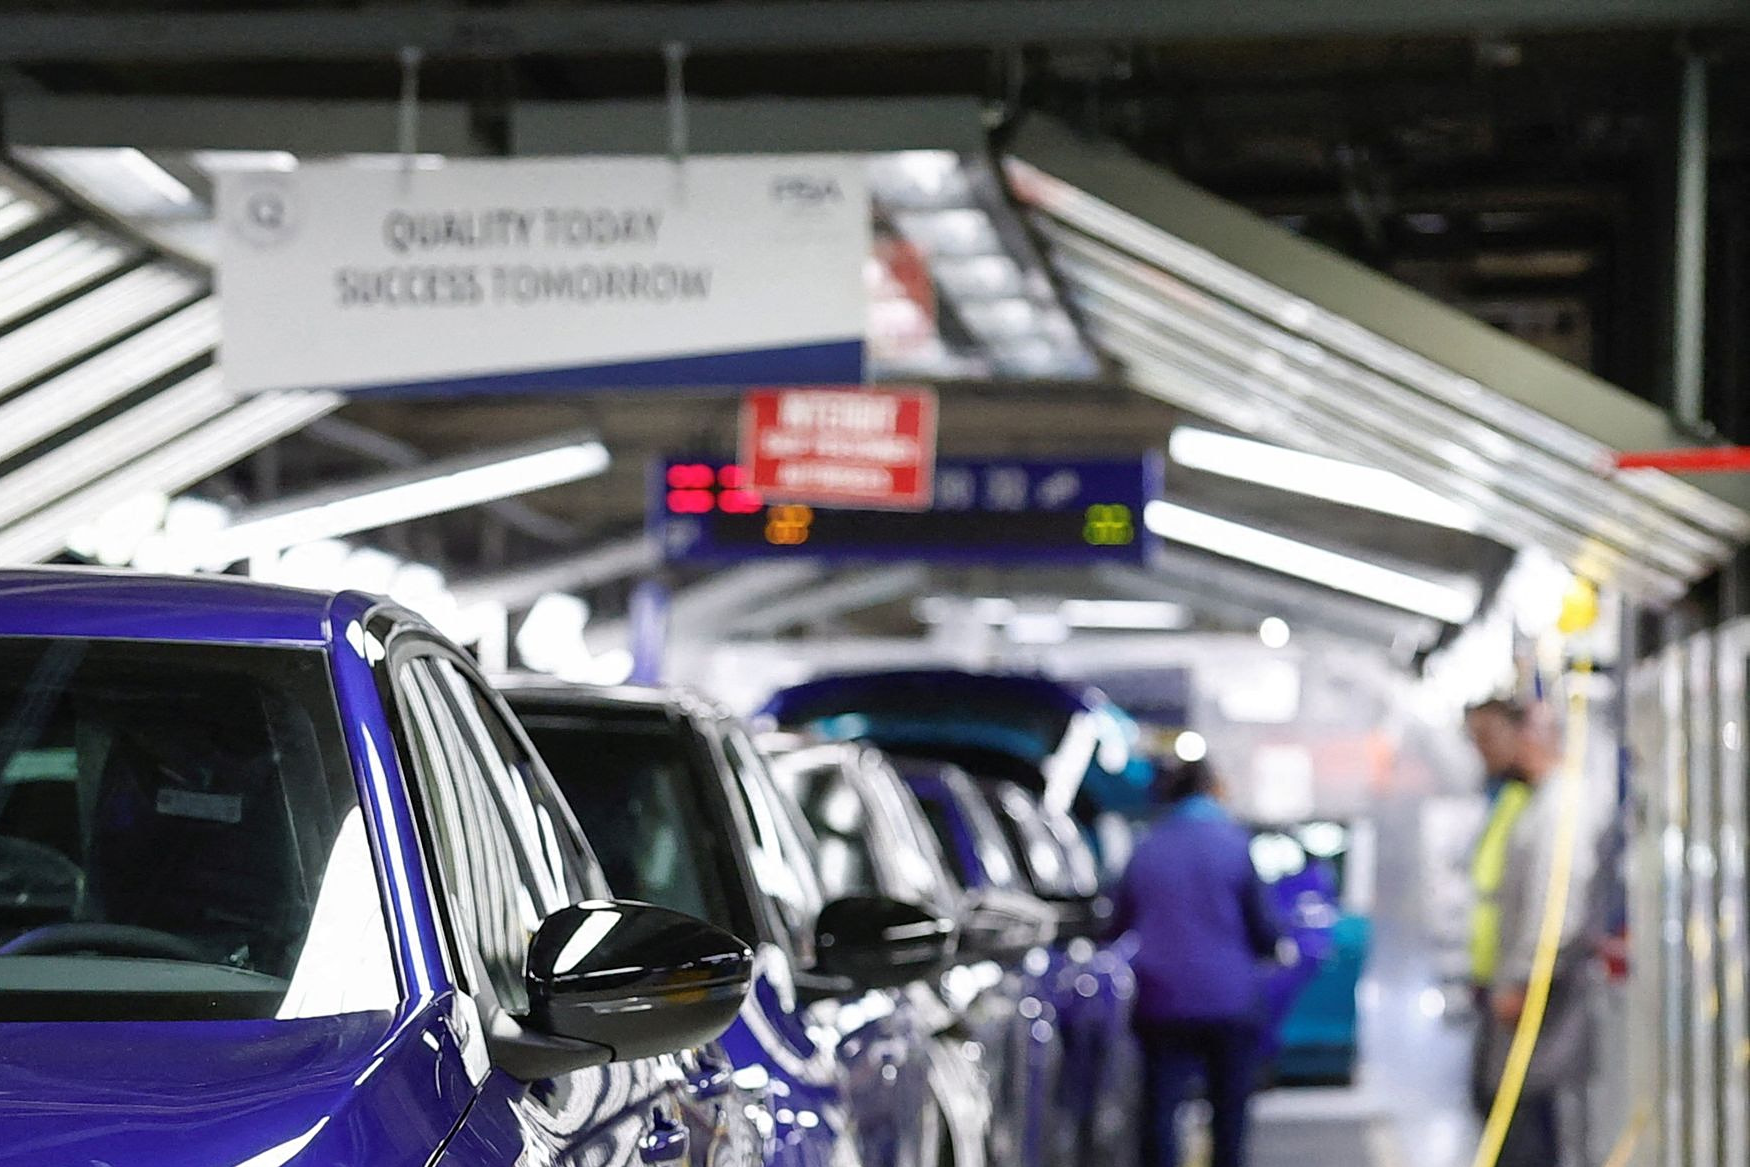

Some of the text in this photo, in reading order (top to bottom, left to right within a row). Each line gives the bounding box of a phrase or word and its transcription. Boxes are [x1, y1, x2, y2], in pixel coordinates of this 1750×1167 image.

[383, 208, 664, 252] QUALITY TODAY
[335, 265, 712, 305] SUCCESS TOMORROW
